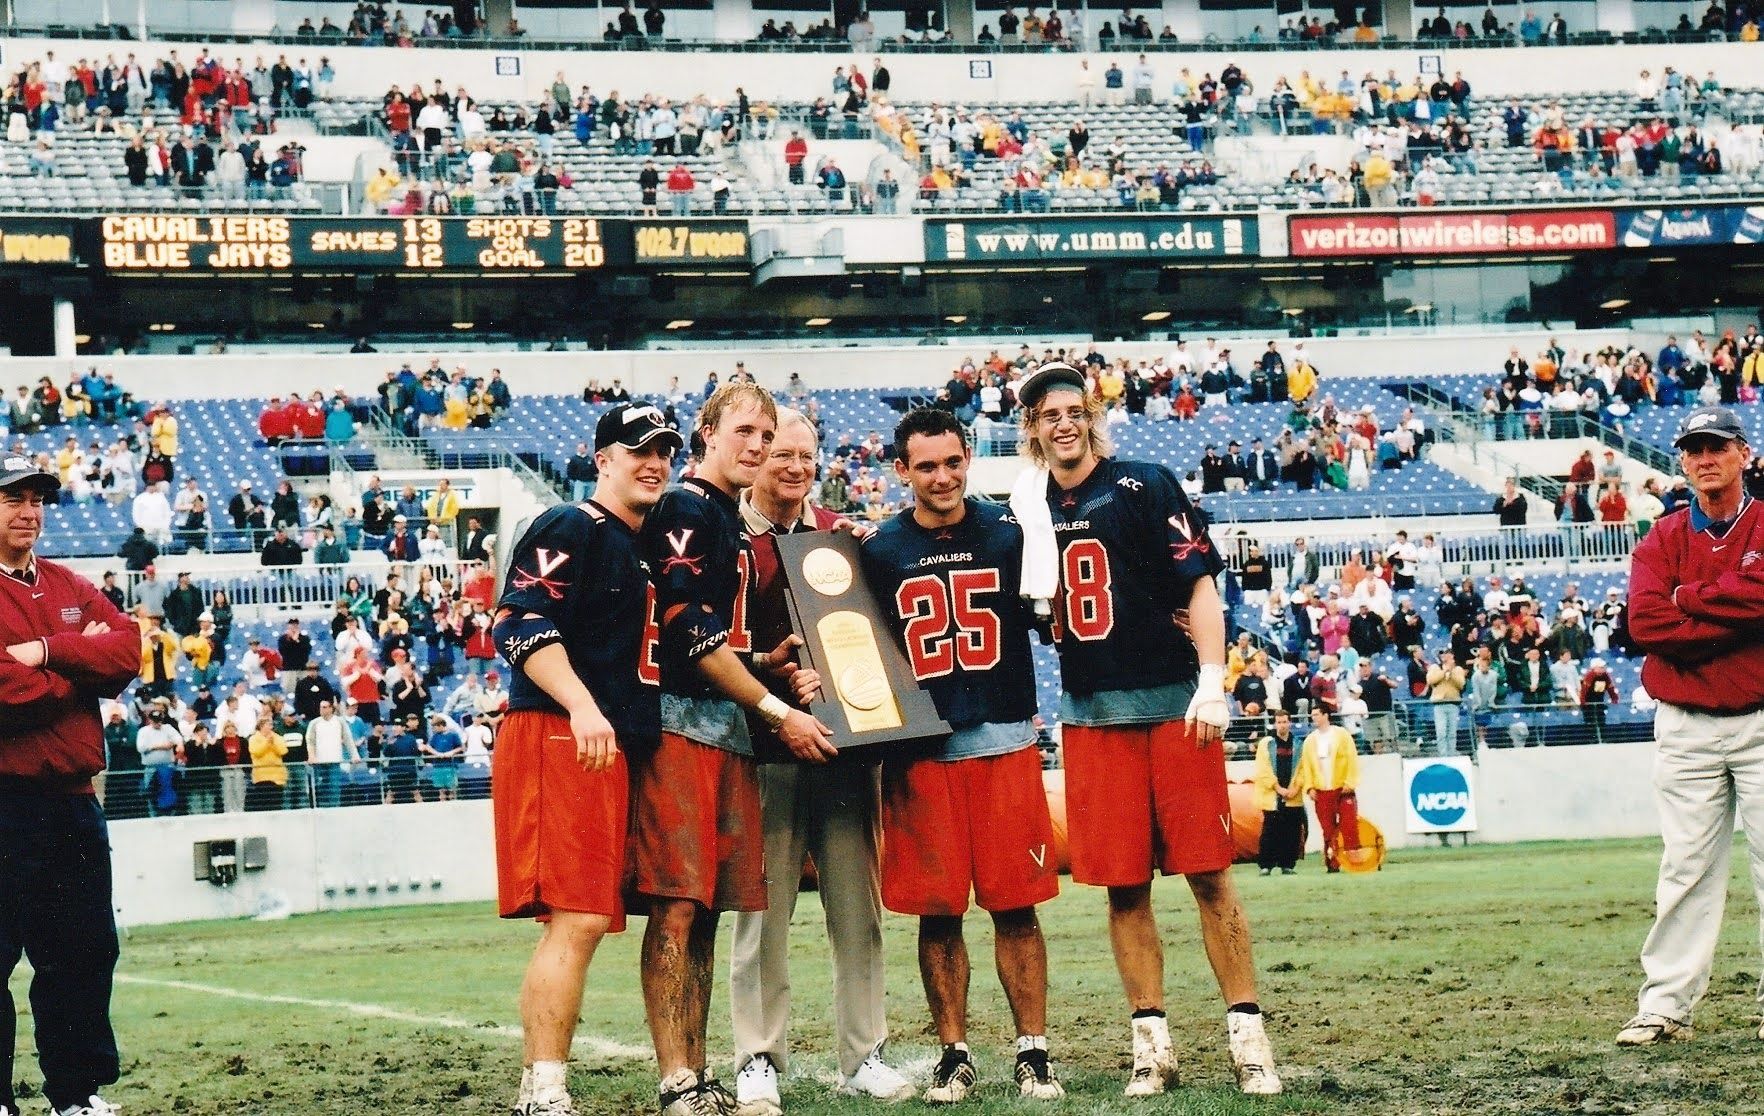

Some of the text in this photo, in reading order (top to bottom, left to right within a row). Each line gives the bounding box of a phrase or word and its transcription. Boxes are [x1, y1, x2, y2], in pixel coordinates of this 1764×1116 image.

[103, 216, 290, 241] CAVALIERS
[404, 219, 441, 241] 13
[466, 218, 551, 237] SHOTS
[563, 219, 600, 241] 21
[976, 222, 1214, 252] www.umm.edu
[1301, 220, 1606, 249] verizonwireless.com
[311, 232, 397, 250] SAVES
[493, 236, 525, 250] ON
[105, 242, 292, 267] BLUE JAYS
[405, 242, 442, 267] 12
[479, 249, 545, 267] GOAL
[564, 242, 604, 267] 20
[1116, 476, 1143, 491] ACC
[999, 514, 1018, 524] AC
[1053, 520, 1090, 533] AVALIERS
[920, 552, 973, 567] CAVALIERS
[1051, 538, 1115, 643] 8
[895, 568, 1001, 681] 25
[689, 630, 728, 657] BRIN
[1416, 791, 1469, 811] NCAA
